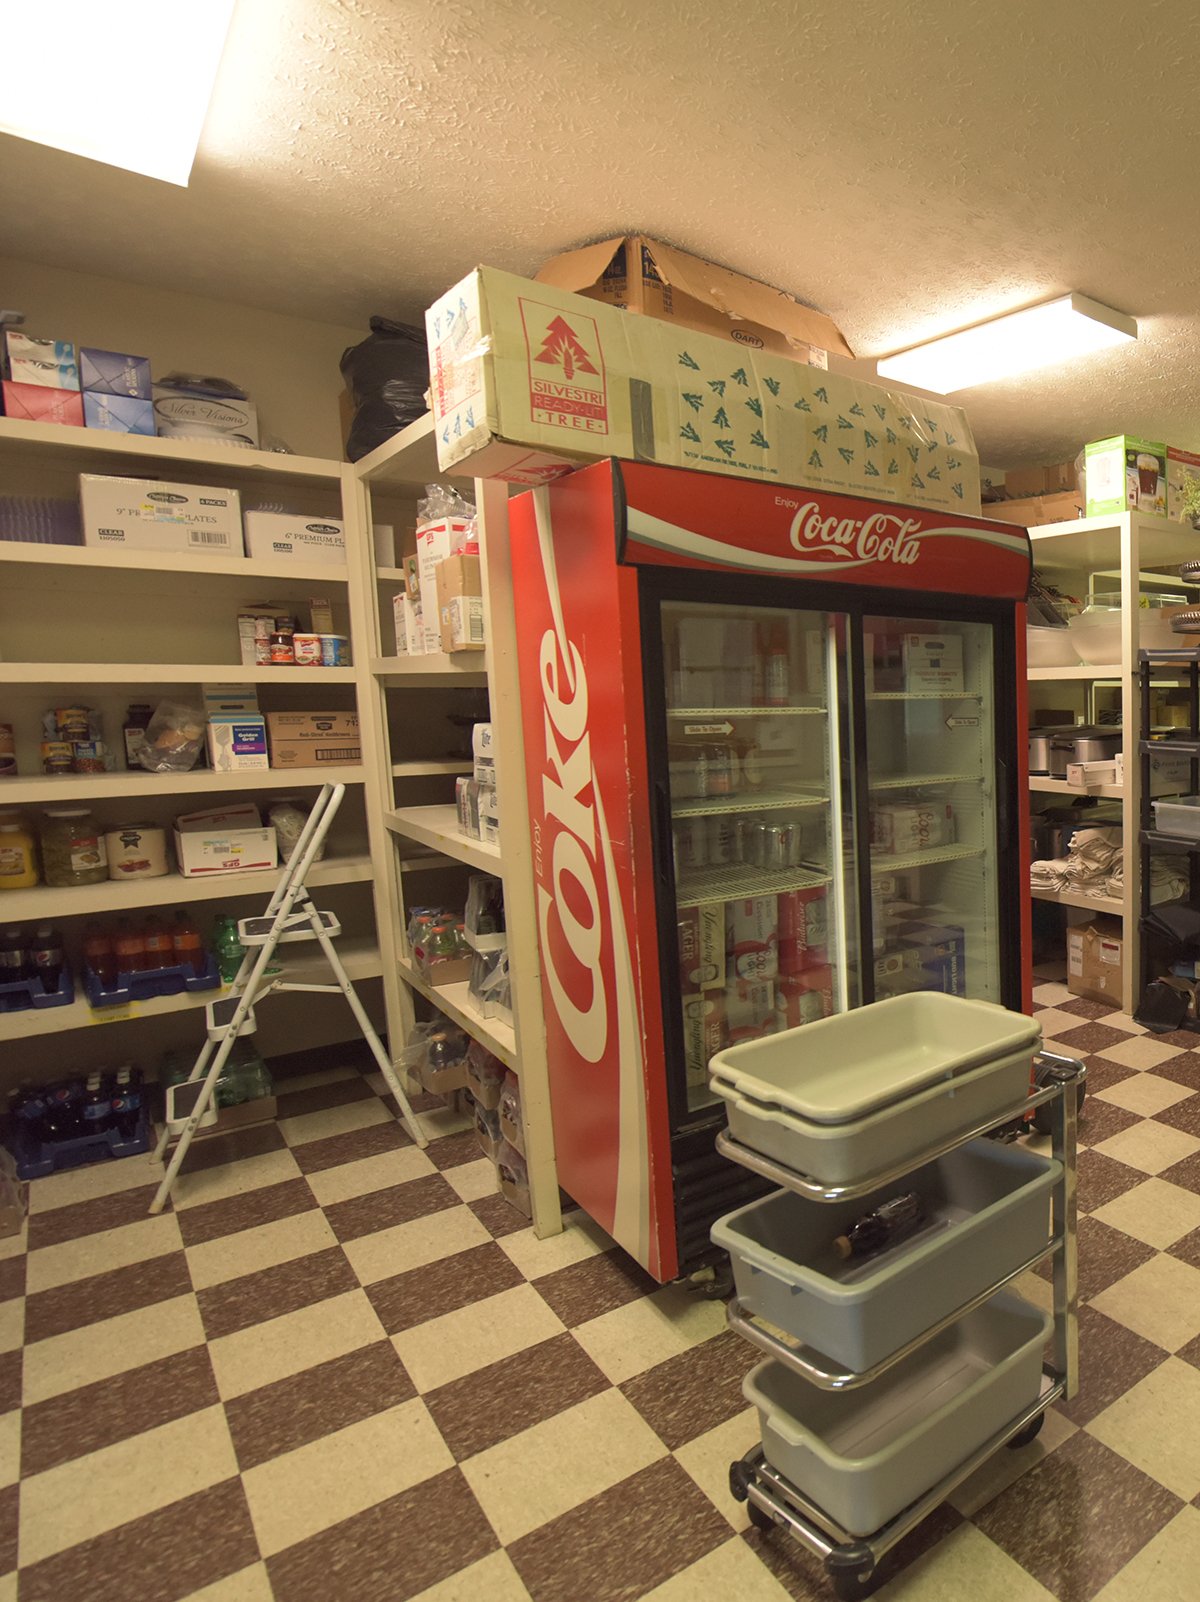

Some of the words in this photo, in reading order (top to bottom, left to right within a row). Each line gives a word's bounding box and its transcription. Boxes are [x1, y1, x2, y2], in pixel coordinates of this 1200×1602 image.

[734, 332, 761, 346] DART
[163, 403, 196, 417] Silver
[201, 407, 243, 424] Visions
[533, 381, 602, 405] SILVESTRI
[545, 411, 594, 430] TREE
[294, 533, 333, 544] PREMIUM
[774, 496, 799, 510] Enjoy
[790, 502, 921, 565] Coca-Cola
[532, 818, 542, 878] Enjoy
[538, 628, 608, 1064] Coke
[702, 906, 718, 964] Yuengling
[797, 902, 807, 955] Budweiser
[689, 1018, 702, 1071] Yuengling
